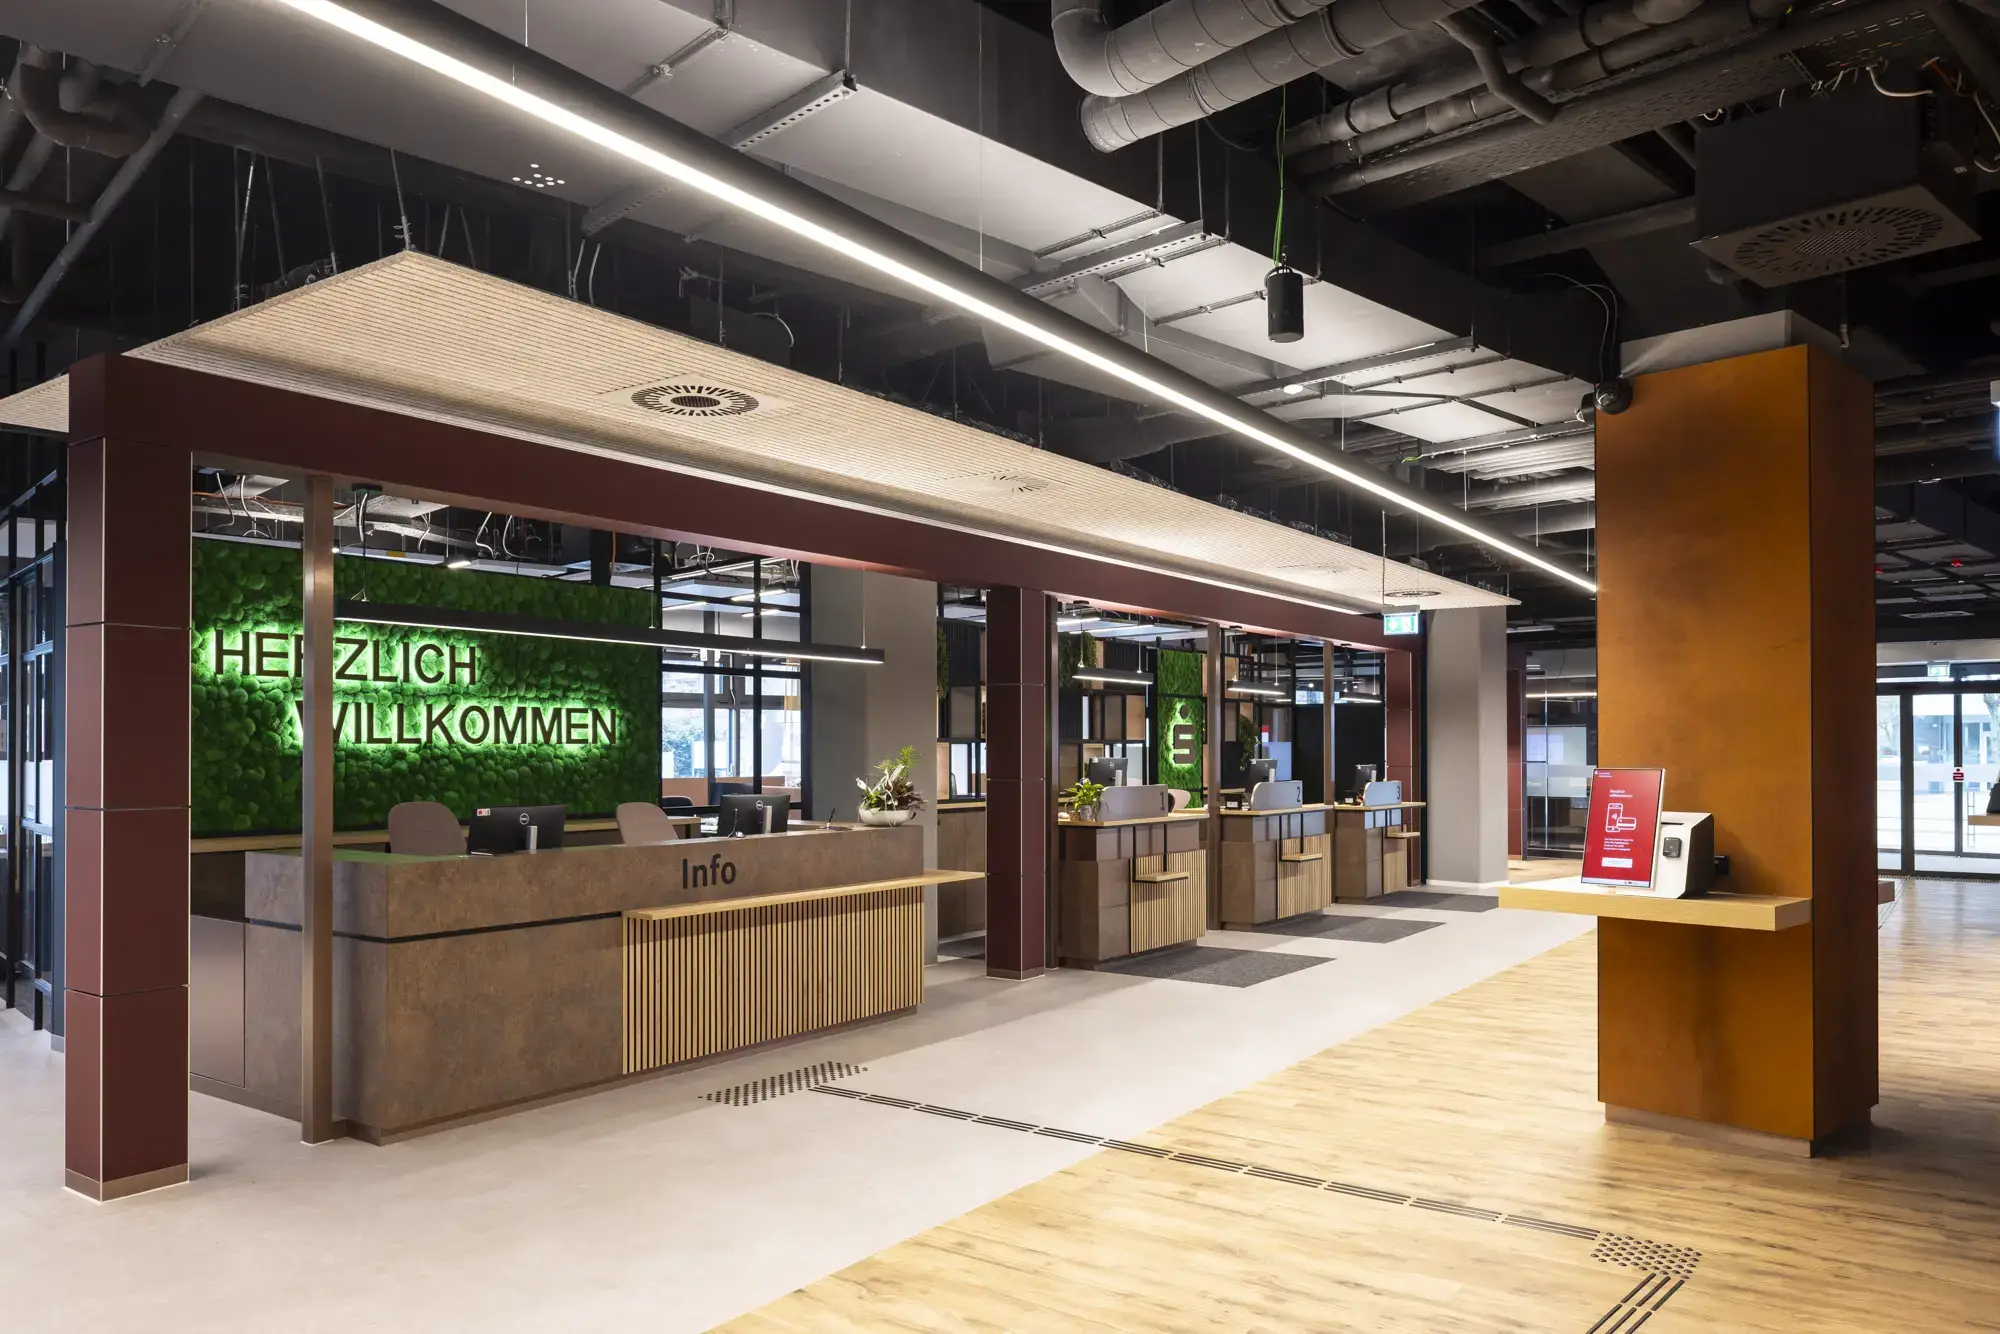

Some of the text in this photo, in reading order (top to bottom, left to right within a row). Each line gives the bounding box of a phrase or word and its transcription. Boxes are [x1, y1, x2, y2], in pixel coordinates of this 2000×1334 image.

[216, 629, 477, 686] HEZLICH
[1159, 791, 1166, 811] 1
[1296, 785, 1301, 803] 2
[1396, 785, 1401, 800] 3
[682, 853, 737, 890] Info
